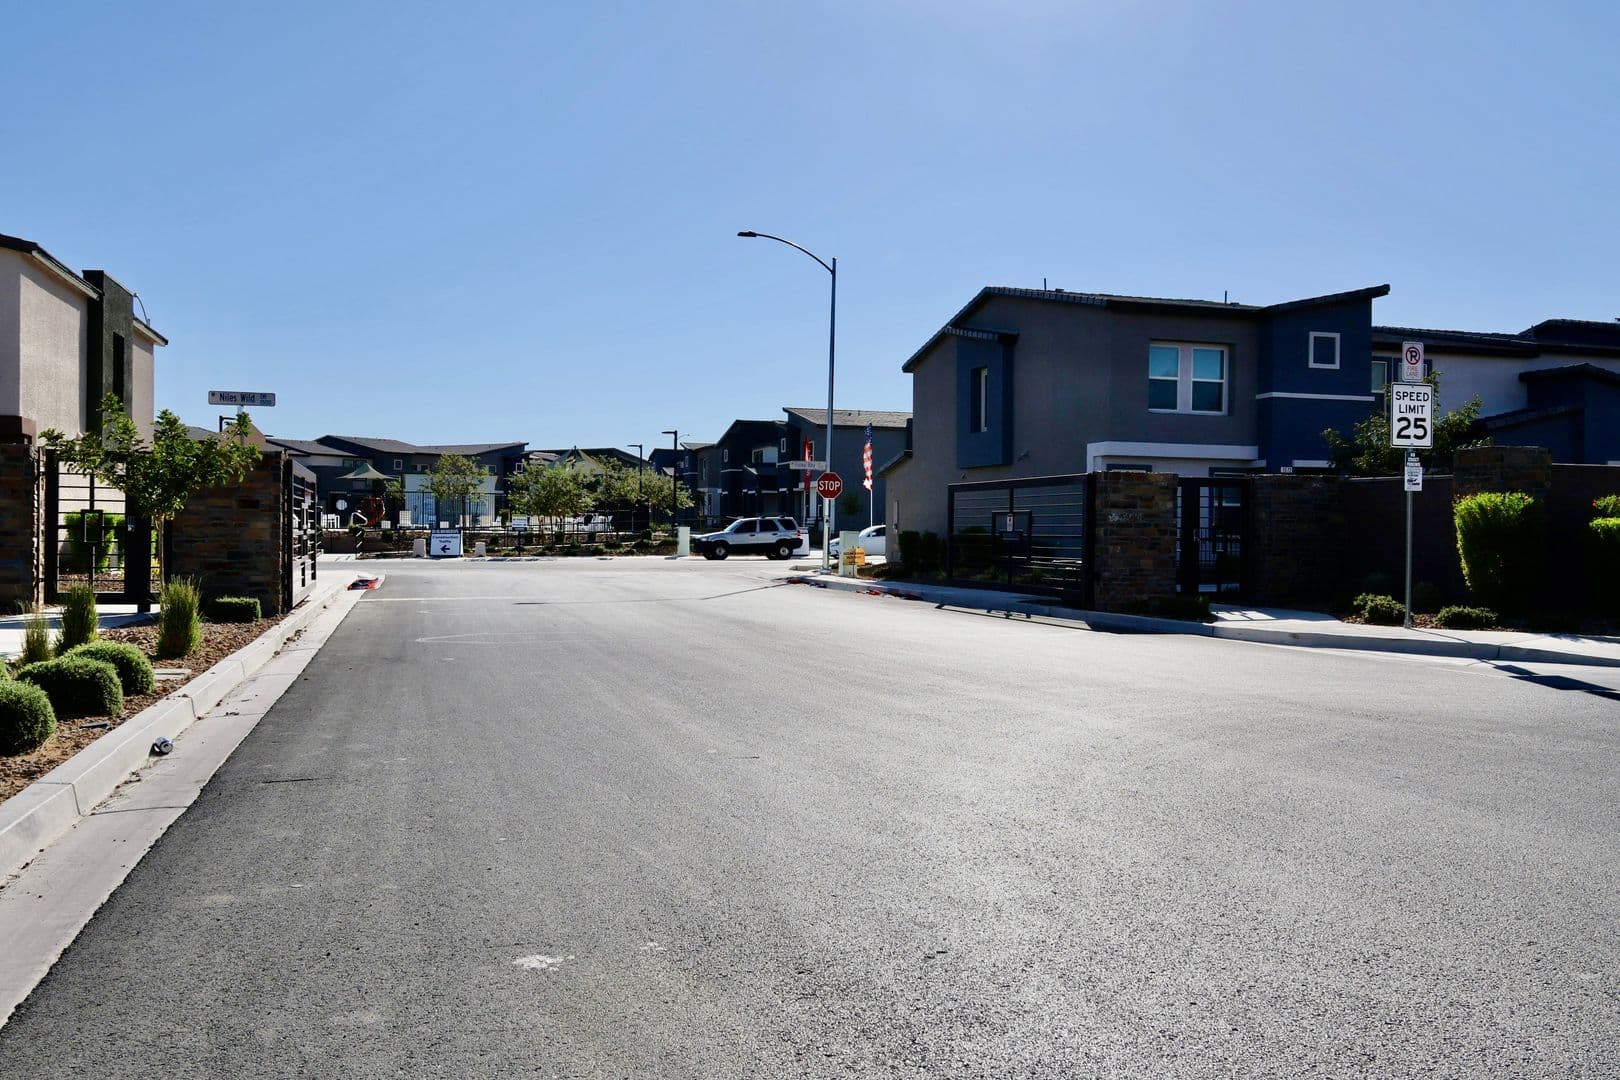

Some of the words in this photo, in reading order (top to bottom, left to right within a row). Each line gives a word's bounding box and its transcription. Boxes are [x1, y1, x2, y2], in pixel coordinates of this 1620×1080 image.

[219, 392, 237, 402] Niles
[240, 392, 256, 403] Wild
[1395, 391, 1430, 402] SPEED
[1398, 404, 1425, 414] LIMIT
[1396, 416, 1428, 440] 25
[818, 480, 841, 491] STOP
